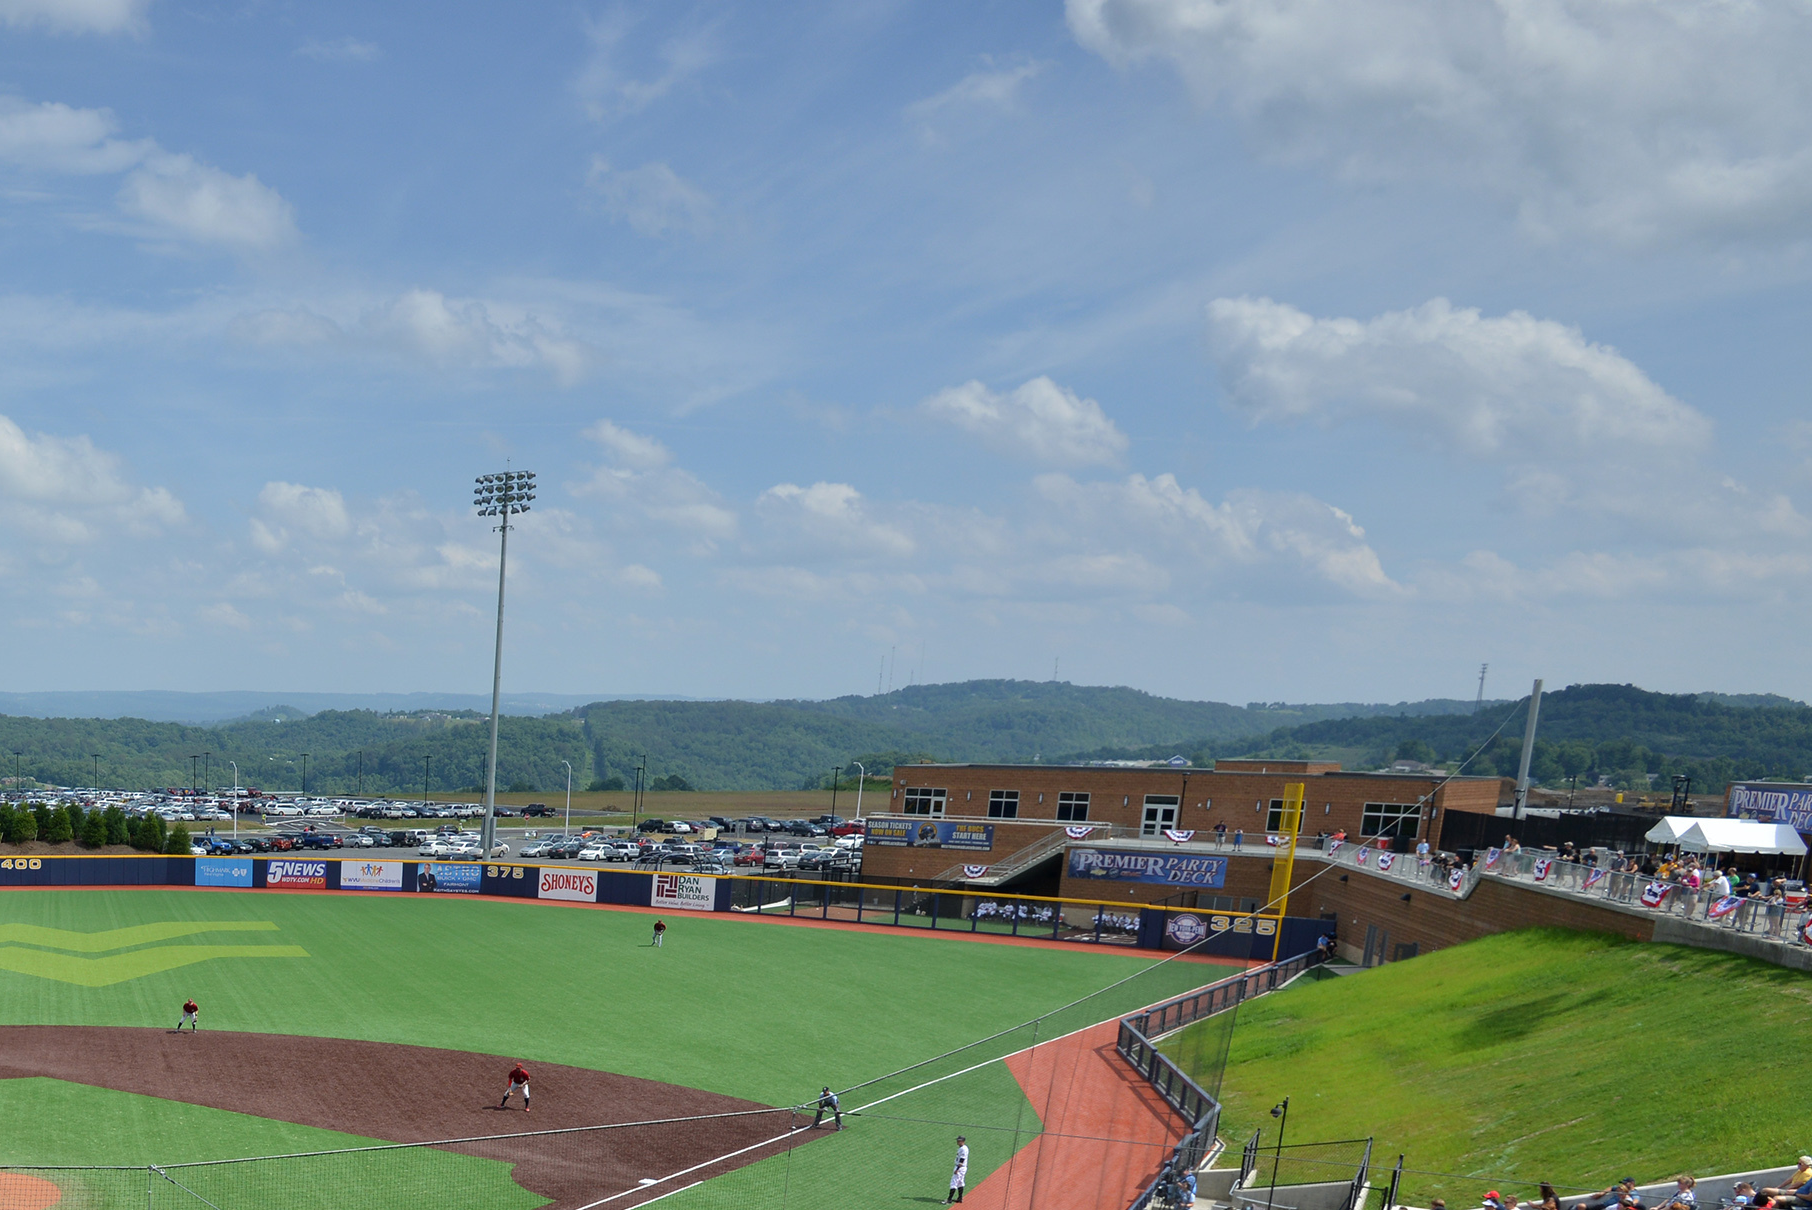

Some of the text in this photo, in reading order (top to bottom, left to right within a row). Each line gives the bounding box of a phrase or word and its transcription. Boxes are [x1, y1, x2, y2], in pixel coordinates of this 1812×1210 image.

[1730, 789, 1812, 821] PREMIER PAR
[868, 820, 912, 830] SEASON TICKETS
[1789, 811, 1812, 831] DEC
[893, 829, 906, 837] SALE
[971, 833, 987, 841] HERE
[0, 858, 42, 870] 400
[1076, 852, 1165, 877] PREMIER
[1165, 857, 1224, 872] PARTY
[267, 861, 326, 884] 5 NEWS
[437, 865, 480, 878] ASTRO
[487, 865, 525, 879] 375
[1167, 870, 1217, 884] DECK
[310, 877, 324, 885] HD
[541, 873, 595, 895] SHONEY'S
[678, 875, 700, 885] DAN
[678, 884, 702, 894] RYAN
[677, 892, 710, 902] BUILDERS
[1210, 915, 1277, 936] 325
